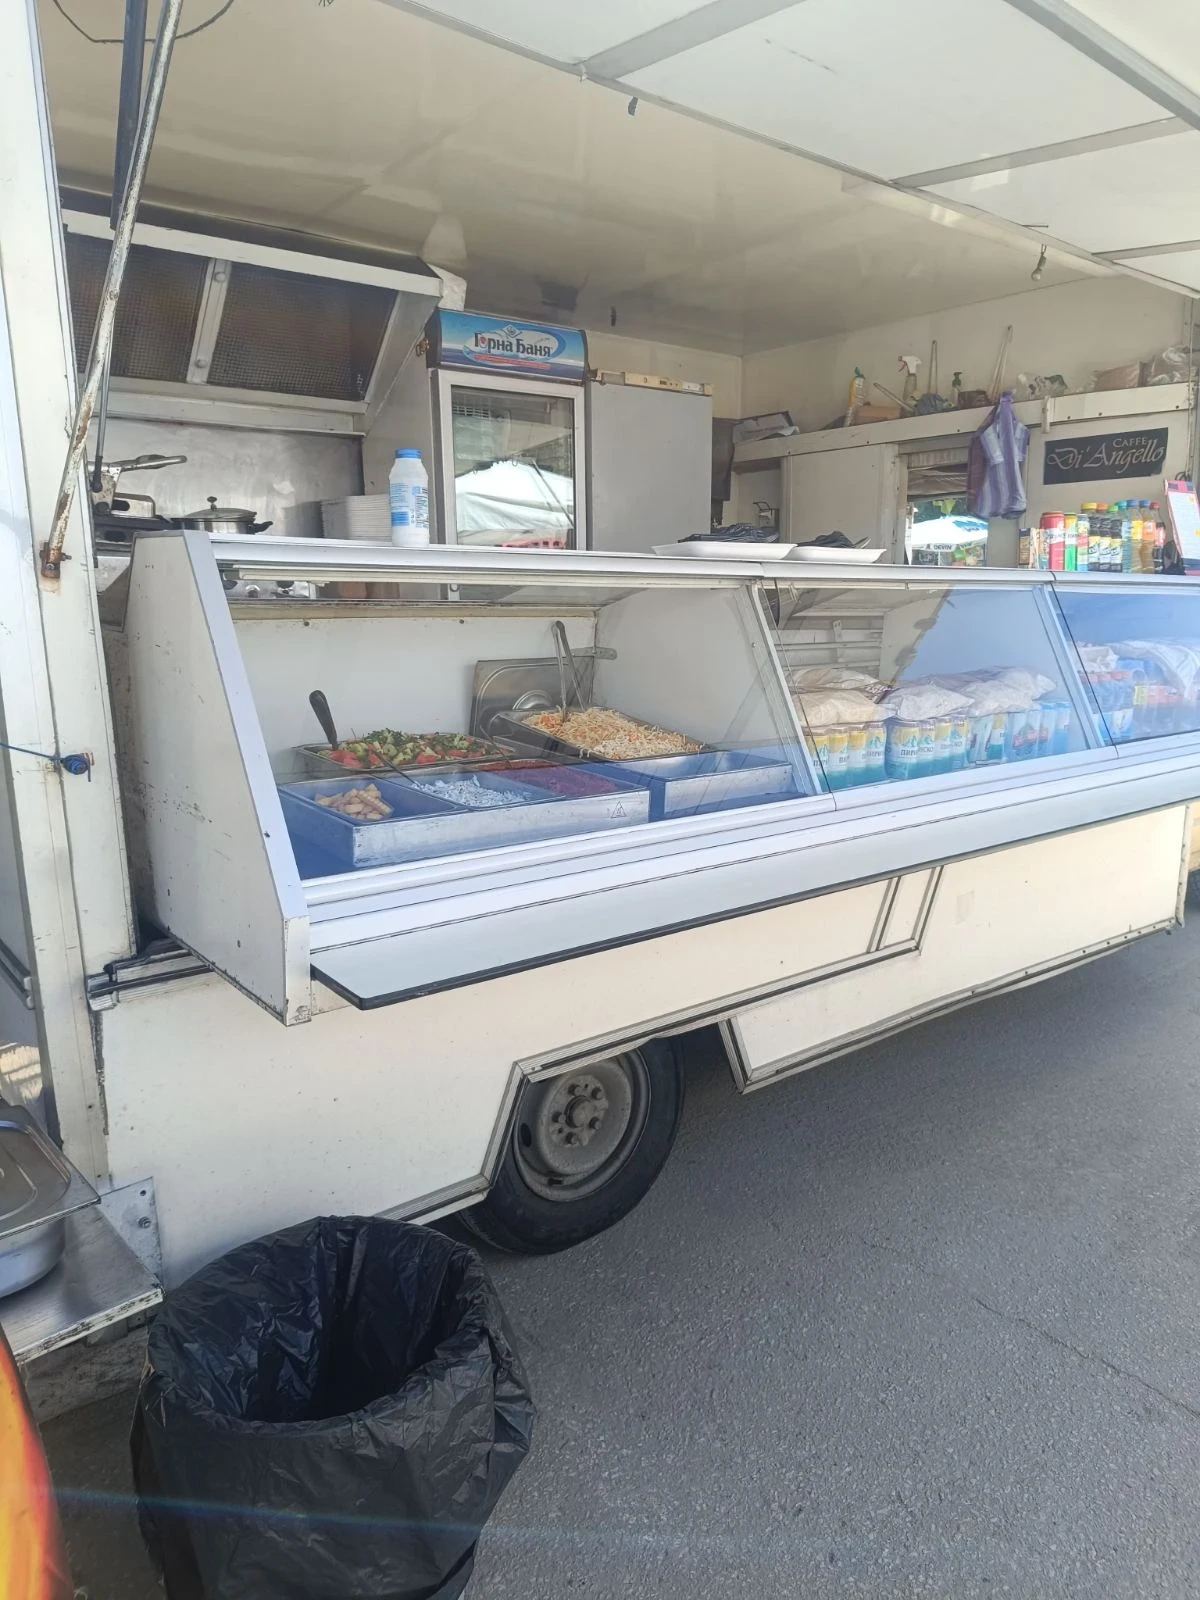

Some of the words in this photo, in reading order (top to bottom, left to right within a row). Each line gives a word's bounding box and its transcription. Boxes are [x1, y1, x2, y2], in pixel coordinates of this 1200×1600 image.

[474, 332, 513, 353] Горна
[515, 339, 551, 357] Баня
[1113, 437, 1148, 448] CAFFE
